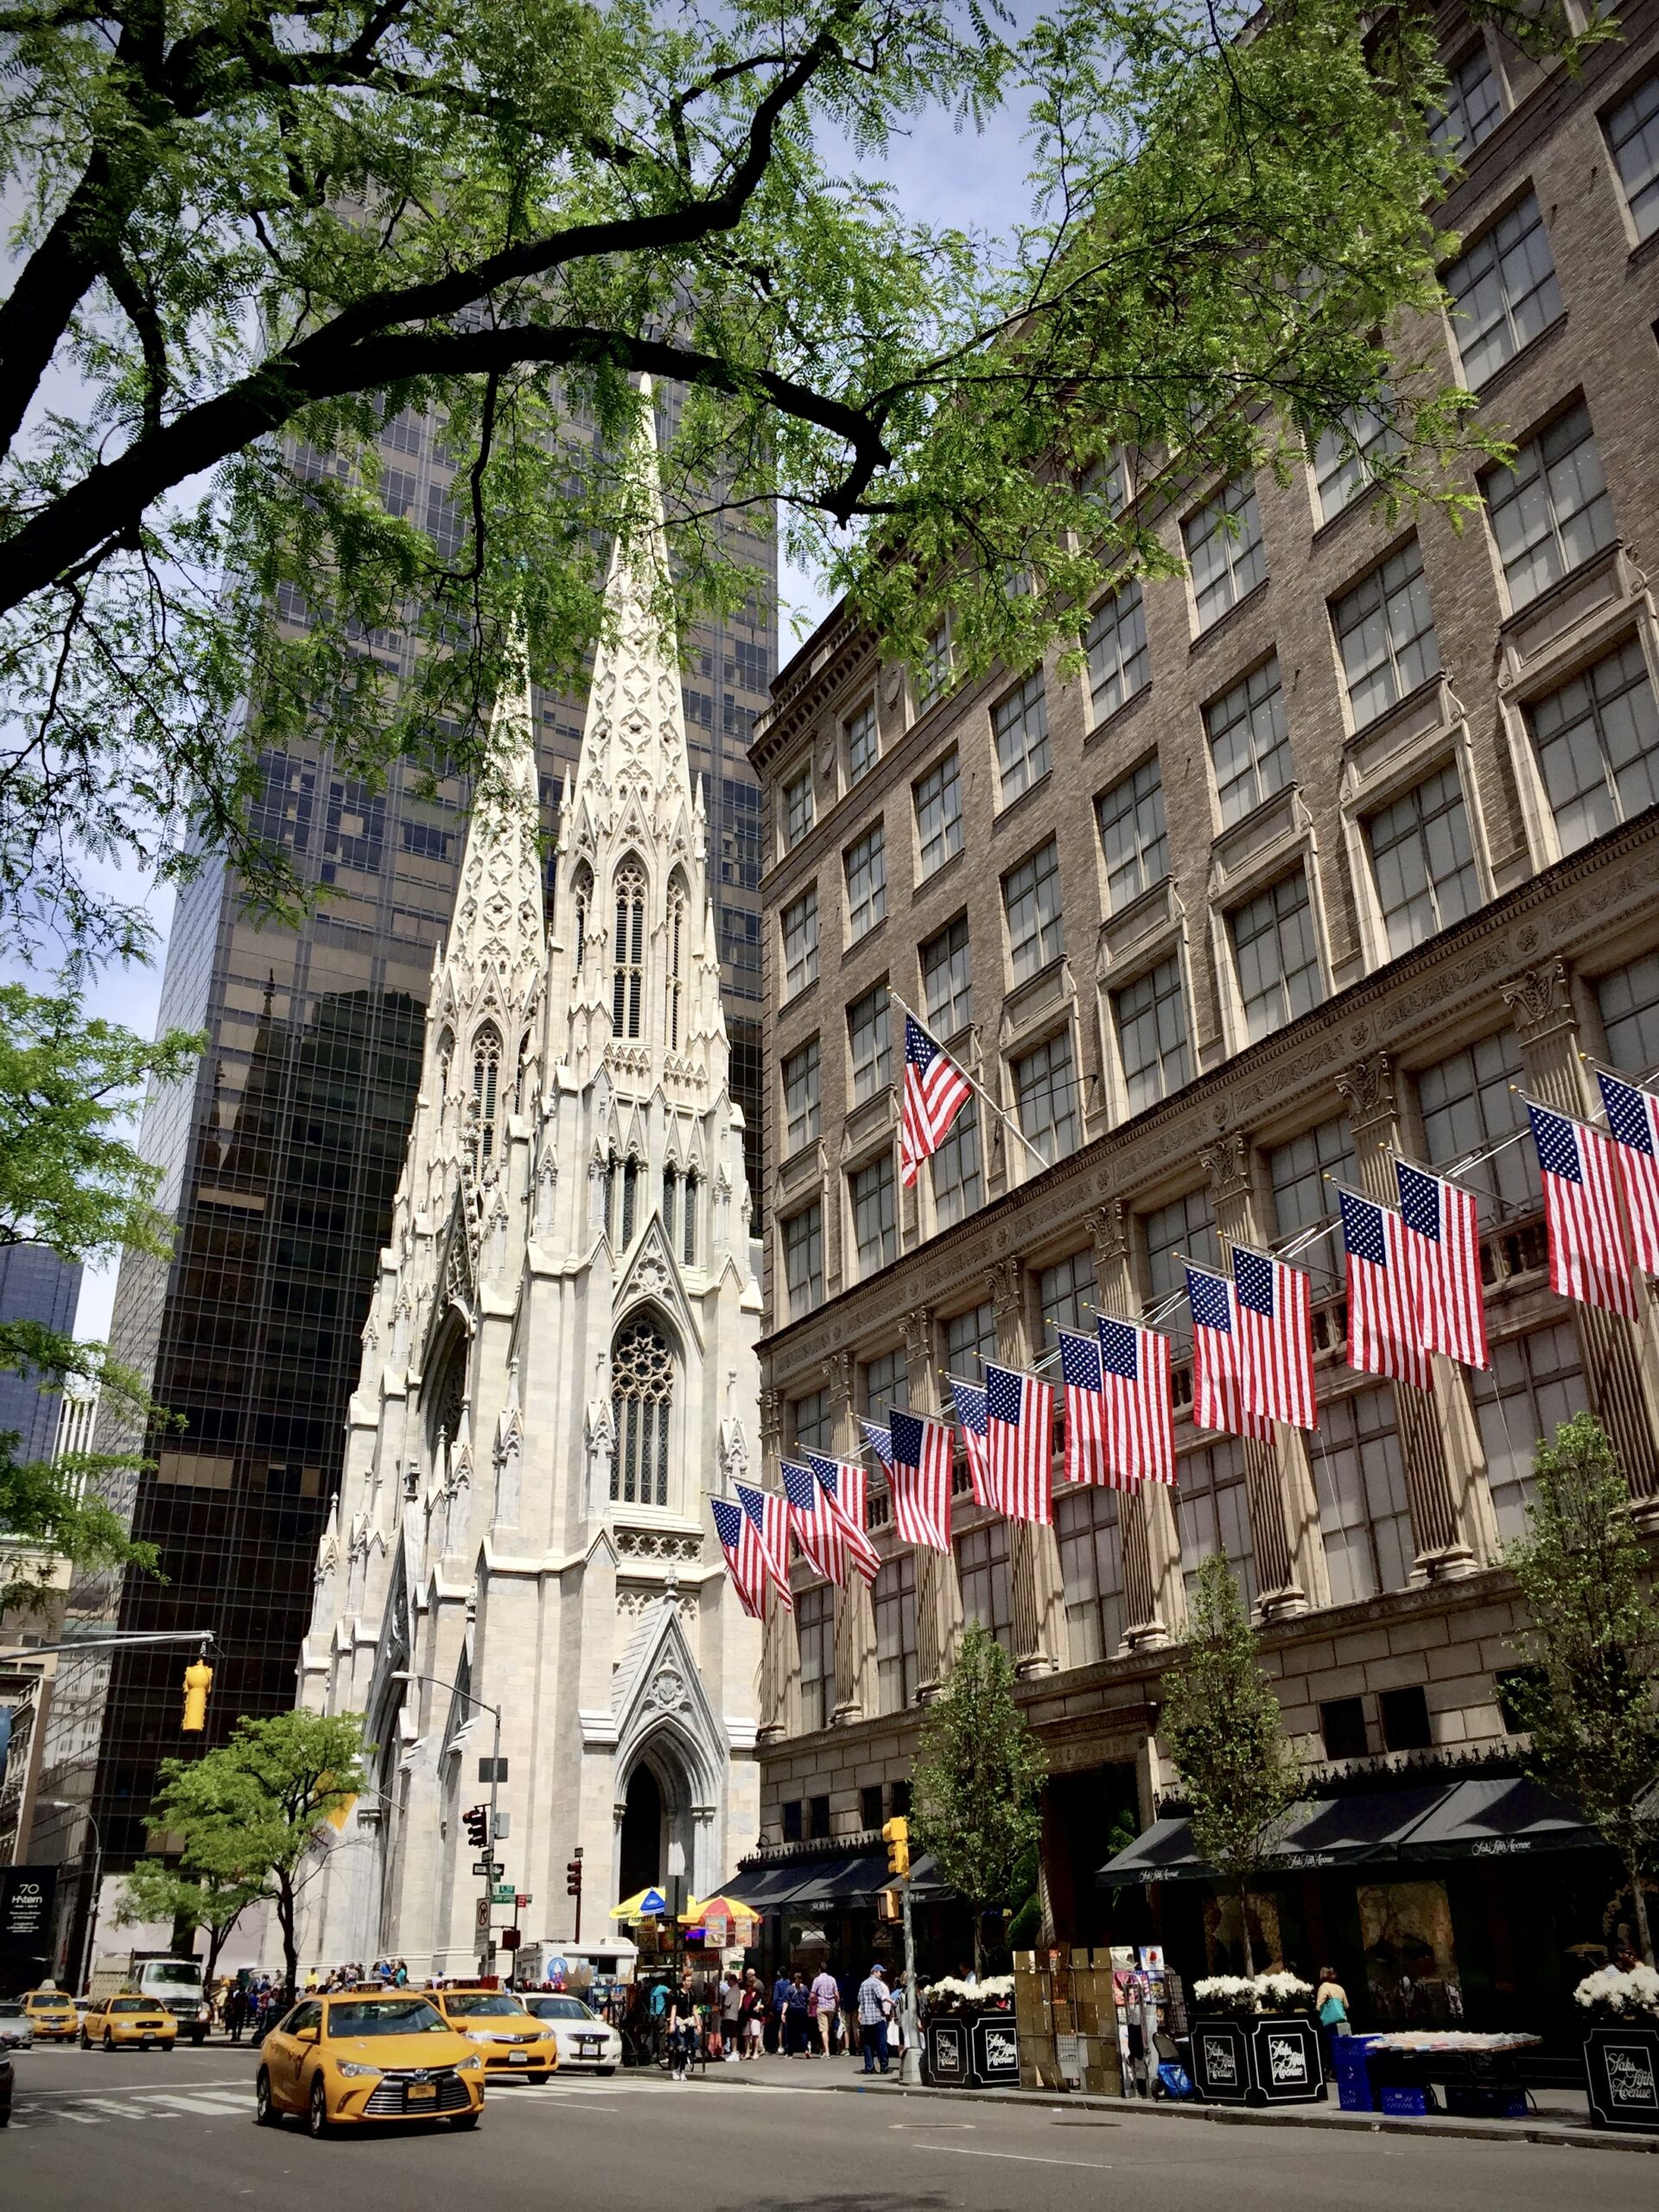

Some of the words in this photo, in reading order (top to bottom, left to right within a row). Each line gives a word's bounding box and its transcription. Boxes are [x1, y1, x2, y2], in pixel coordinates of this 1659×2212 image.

[1489, 1840, 1507, 1854] Fifth
[1503, 1839, 1532, 1853] Avenue
[20, 1884, 40, 1894] 70
[988, 2033, 1007, 2050] Saks
[997, 2043, 1016, 2057] Fifth
[1206, 2041, 1224, 2059] Saks
[1270, 2040, 1293, 2060] Saks
[988, 2050, 1014, 2066] Avenue
[1216, 2053, 1235, 2069] Fifth
[1281, 2051, 1305, 2069] Fifth
[1607, 2053, 1636, 2075] Saks
[1208, 2061, 1234, 2080] Avenue
[1273, 2061, 1303, 2079] Avenue
[1624, 2069, 1654, 2088] Fifth
[1611, 2078, 1651, 2101] Avenue
